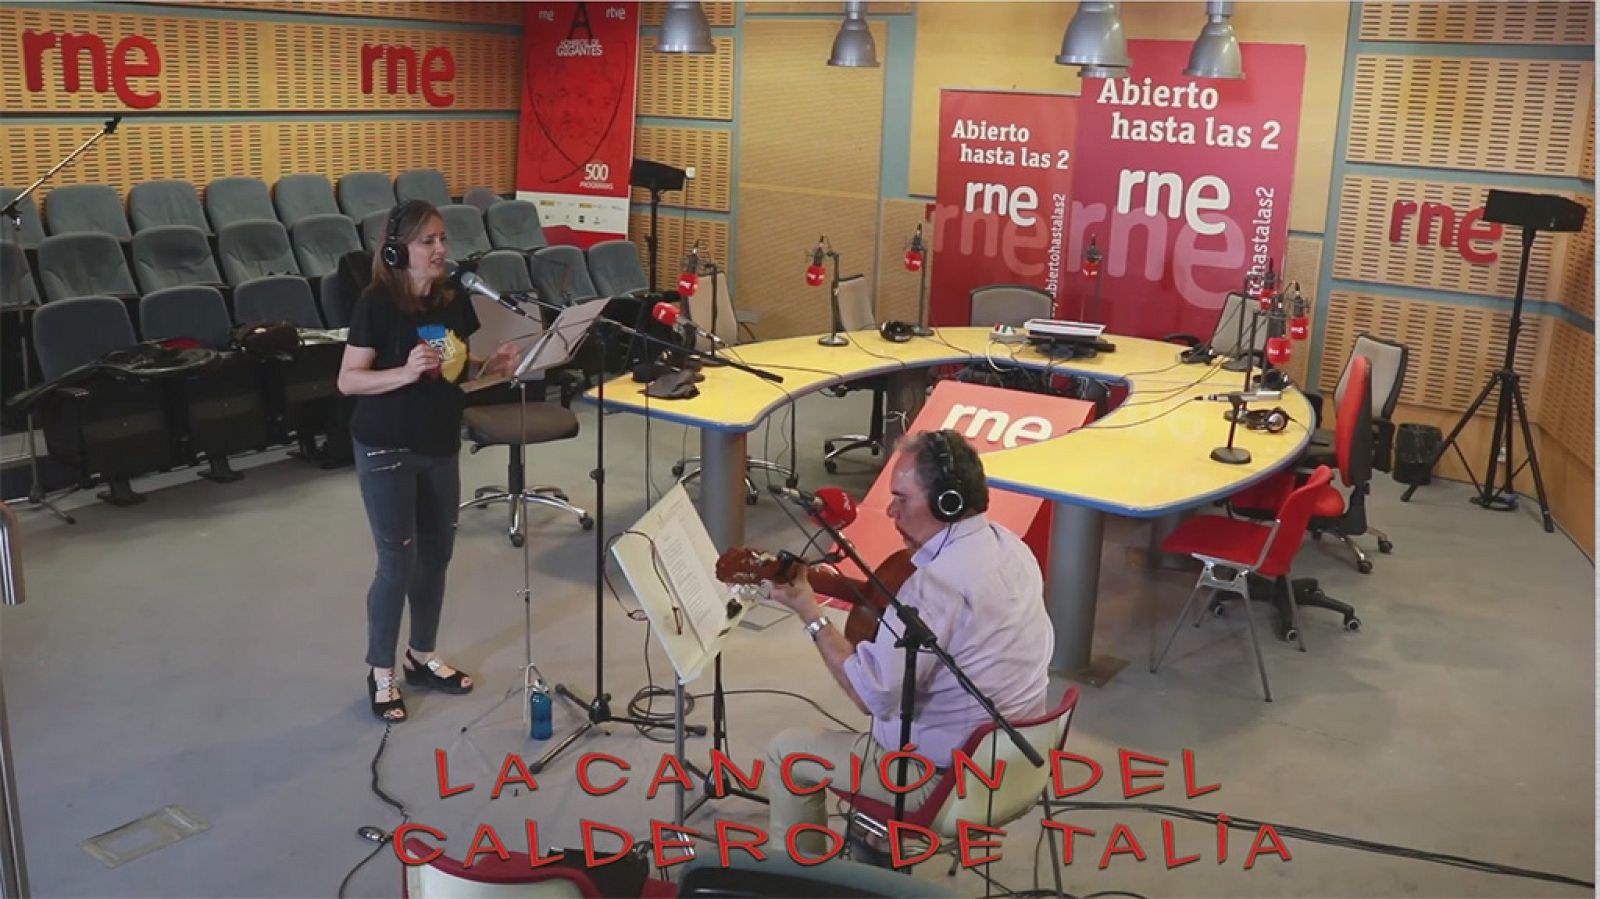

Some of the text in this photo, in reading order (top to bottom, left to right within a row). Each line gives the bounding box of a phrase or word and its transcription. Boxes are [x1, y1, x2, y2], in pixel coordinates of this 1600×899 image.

[22, 28, 161, 109] rne
[361, 44, 456, 108] rne
[1097, 77, 1219, 110] Abierto
[951, 119, 1029, 143] Abierto
[1110, 111, 1281, 150] hasta las 2
[584, 163, 609, 181] 500
[960, 143, 1070, 170] hasta las 2
[965, 181, 1039, 226] rne
[1117, 168, 1231, 235] rne
[1389, 199, 1504, 263] rne
[940, 403, 1054, 448] rne
